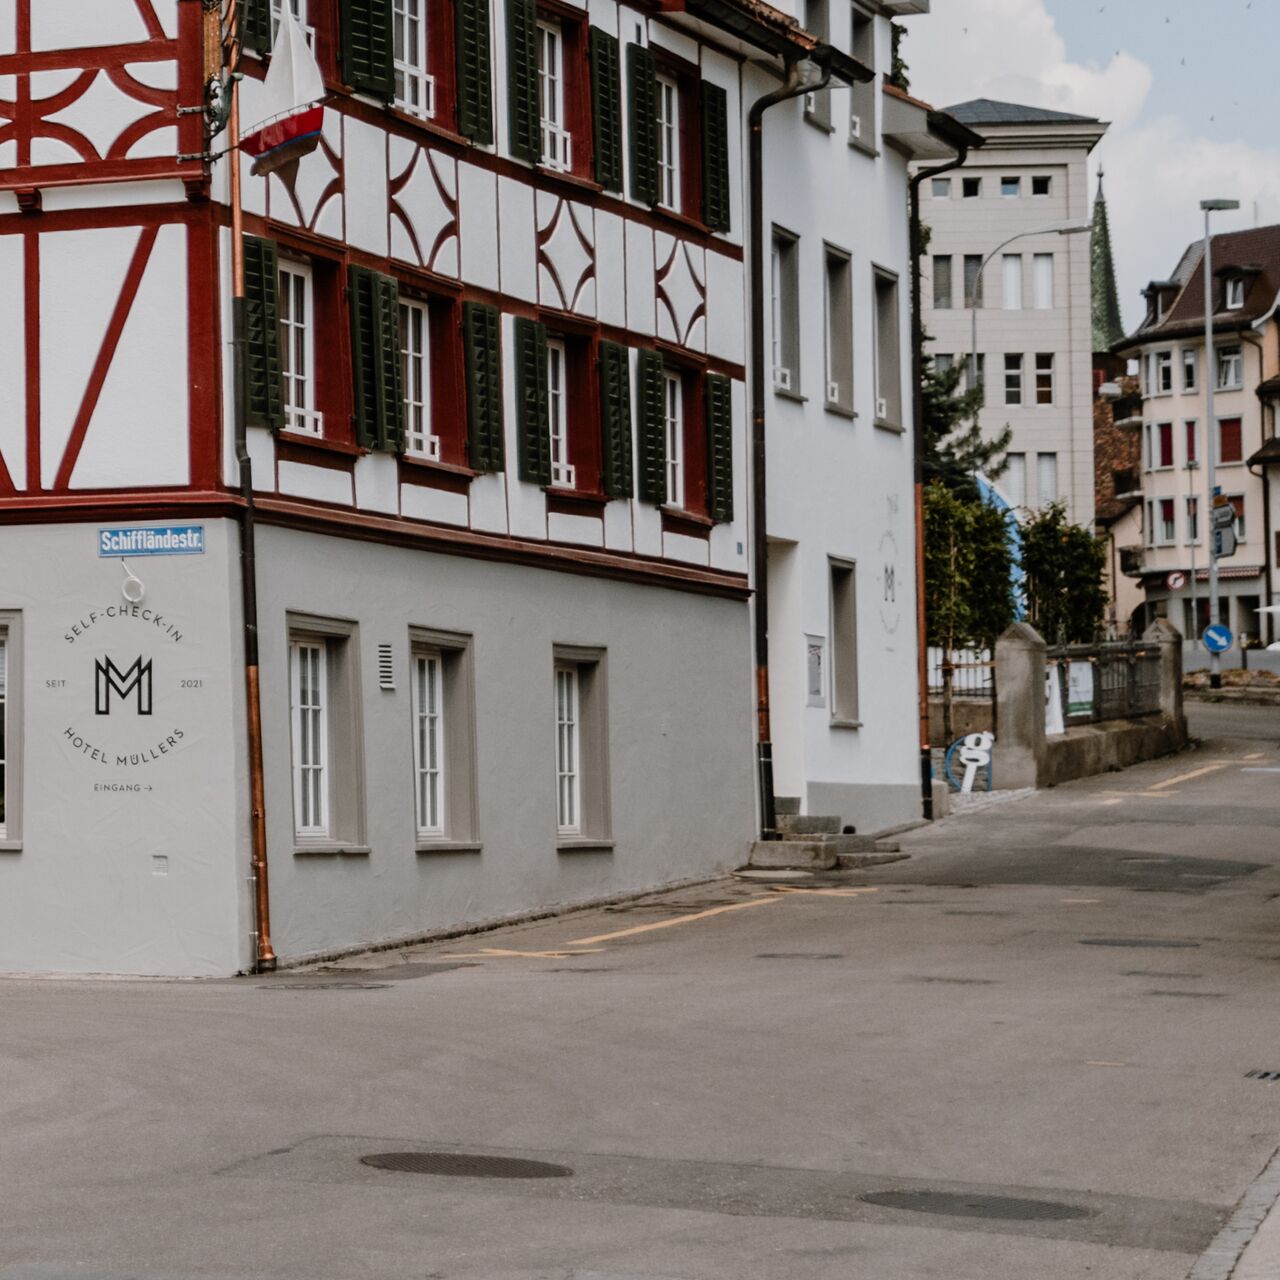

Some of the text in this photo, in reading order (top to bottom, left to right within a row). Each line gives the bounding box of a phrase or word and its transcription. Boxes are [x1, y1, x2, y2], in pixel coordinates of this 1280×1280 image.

[101, 528, 202, 552] Schiffländestr.
[64, 605, 184, 645] SELF-CHECK-IN
[45, 679, 67, 689] SEIT
[180, 679, 204, 689] 2021
[63, 726, 186, 767] HOTEL MÜLLERS
[93, 783, 142, 793] EINGANG
